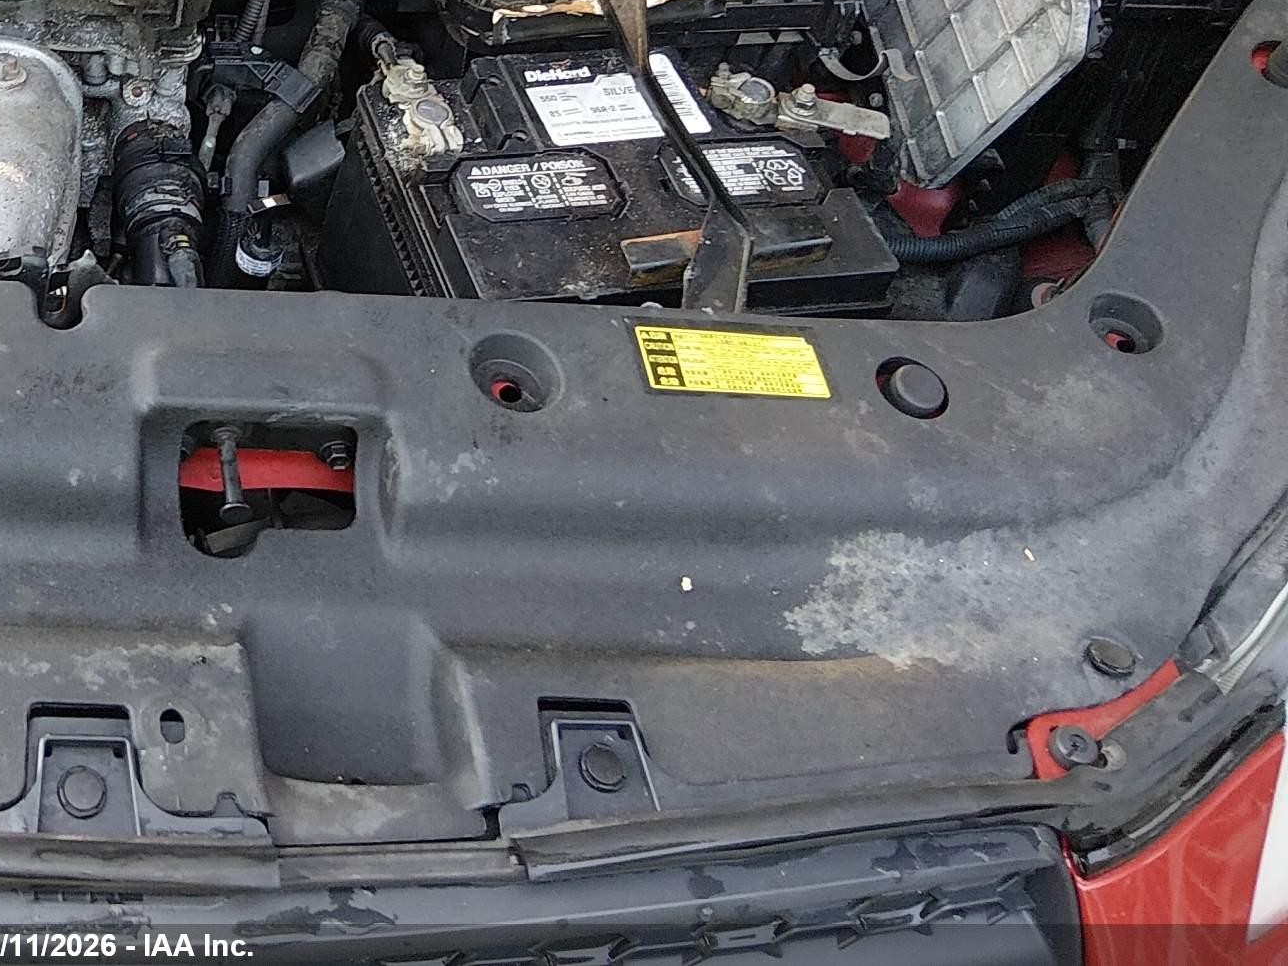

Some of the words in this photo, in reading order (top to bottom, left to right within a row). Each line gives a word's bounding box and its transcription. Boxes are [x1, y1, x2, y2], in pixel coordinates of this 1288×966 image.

[524, 66, 591, 83] DieHard
[603, 86, 636, 97] SILVE
[481, 163, 532, 175] DANGER
[533, 163, 539, 172] /
[541, 159, 586, 171] POISON
